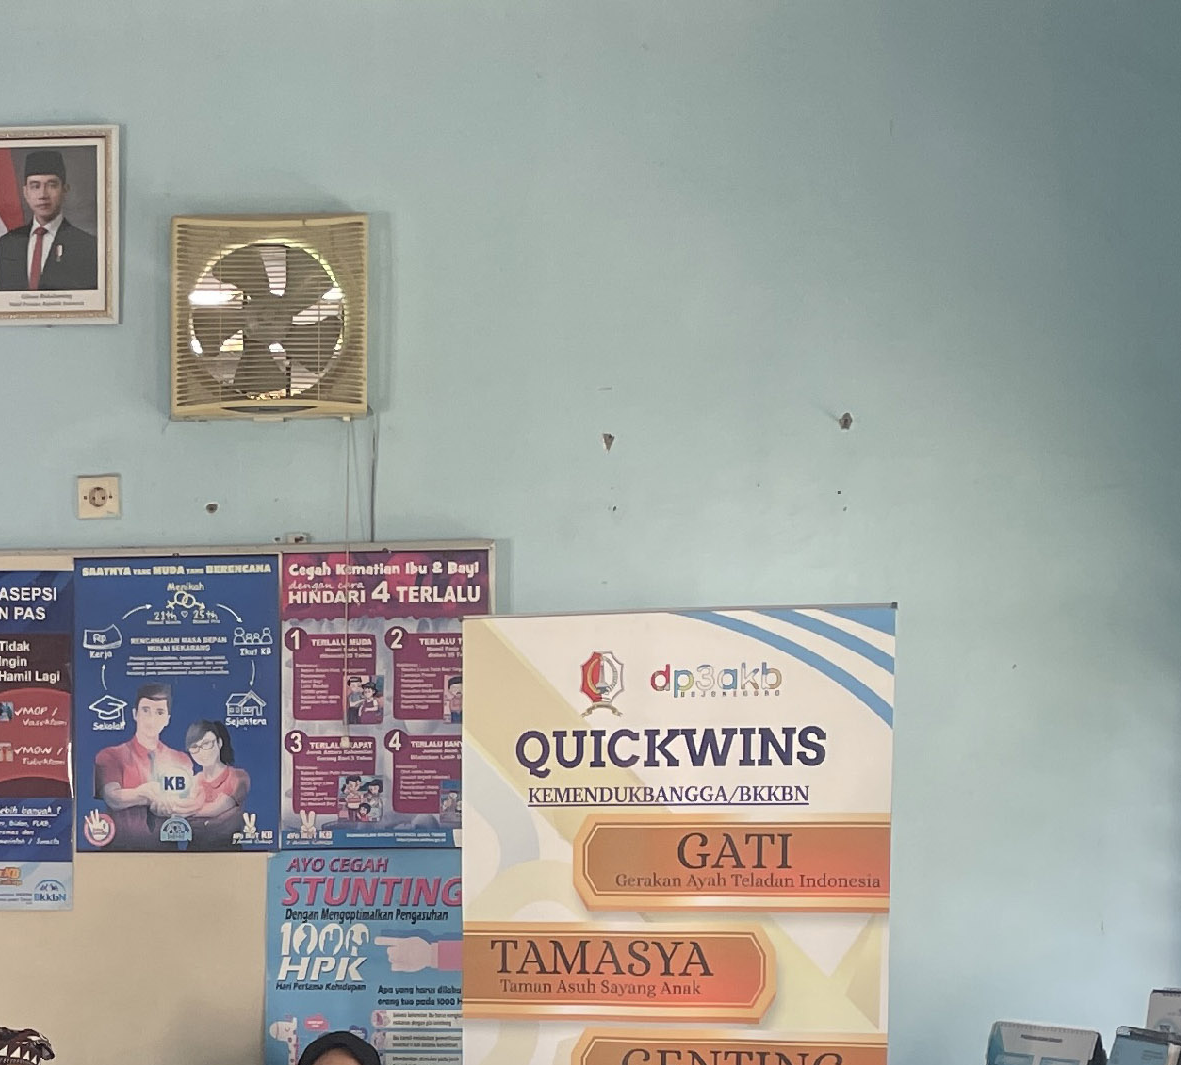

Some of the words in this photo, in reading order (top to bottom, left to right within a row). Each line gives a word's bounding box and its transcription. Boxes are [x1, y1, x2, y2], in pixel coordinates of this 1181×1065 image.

[153, 566, 185, 575] MUDA
[205, 563, 272, 574] BERENCANA
[288, 561, 331, 577] Cegah
[335, 562, 400, 575] Kematian
[405, 562, 427, 574] Ibu
[431, 561, 443, 574] &
[447, 561, 480, 578] Bayi
[288, 580, 335, 593] dengan
[288, 590, 366, 604] HINDARI
[371, 580, 391, 603] 4
[396, 585, 481, 603] TERLALU
[13, 606, 46, 620] PAS
[289, 629, 300, 650] 1
[390, 628, 404, 649] 2
[35, 670, 61, 684] Lagi
[650, 661, 783, 698] dp3akb
[225, 716, 267, 728] Sejahtera
[290, 731, 303, 753] 3
[310, 741, 342, 749] TERLAL
[350, 741, 373, 749] APAT
[388, 731, 402, 751] 4
[514, 725, 827, 778] QUICKWINS
[164, 776, 186, 791] KB
[528, 784, 809, 806] KEMENDUKBANGGA/BKKBN
[676, 831, 793, 870] GATI
[285, 857, 326, 873] AYO
[328, 856, 390, 873] CEGAH
[281, 875, 463, 908] STUNTING
[615, 872, 682, 888] Gerakan
[686, 873, 727, 891] Ayah
[730, 873, 795, 888] Teladan
[800, 873, 881, 889] Indonesia
[285, 908, 319, 924] Dengan
[320, 908, 394, 925] Mengoptimalkan
[395, 909, 449, 925] Pengasuhan
[280, 921, 370, 957] 1000
[490, 939, 715, 977] TAMASYA
[277, 956, 368, 982] HPK
[276, 982, 293, 991] Hari
[294, 982, 324, 991] Pertama
[325, 982, 367, 992] Kehidupan
[378, 985, 394, 995] Apa
[395, 986, 415, 995] yang
[416, 985, 436, 994] harus
[499, 978, 552, 994] Taman
[557, 979, 596, 994] Asuh
[600, 980, 656, 998] Sayang
[660, 980, 701, 995] Anak
[415, 997, 435, 1008] pada
